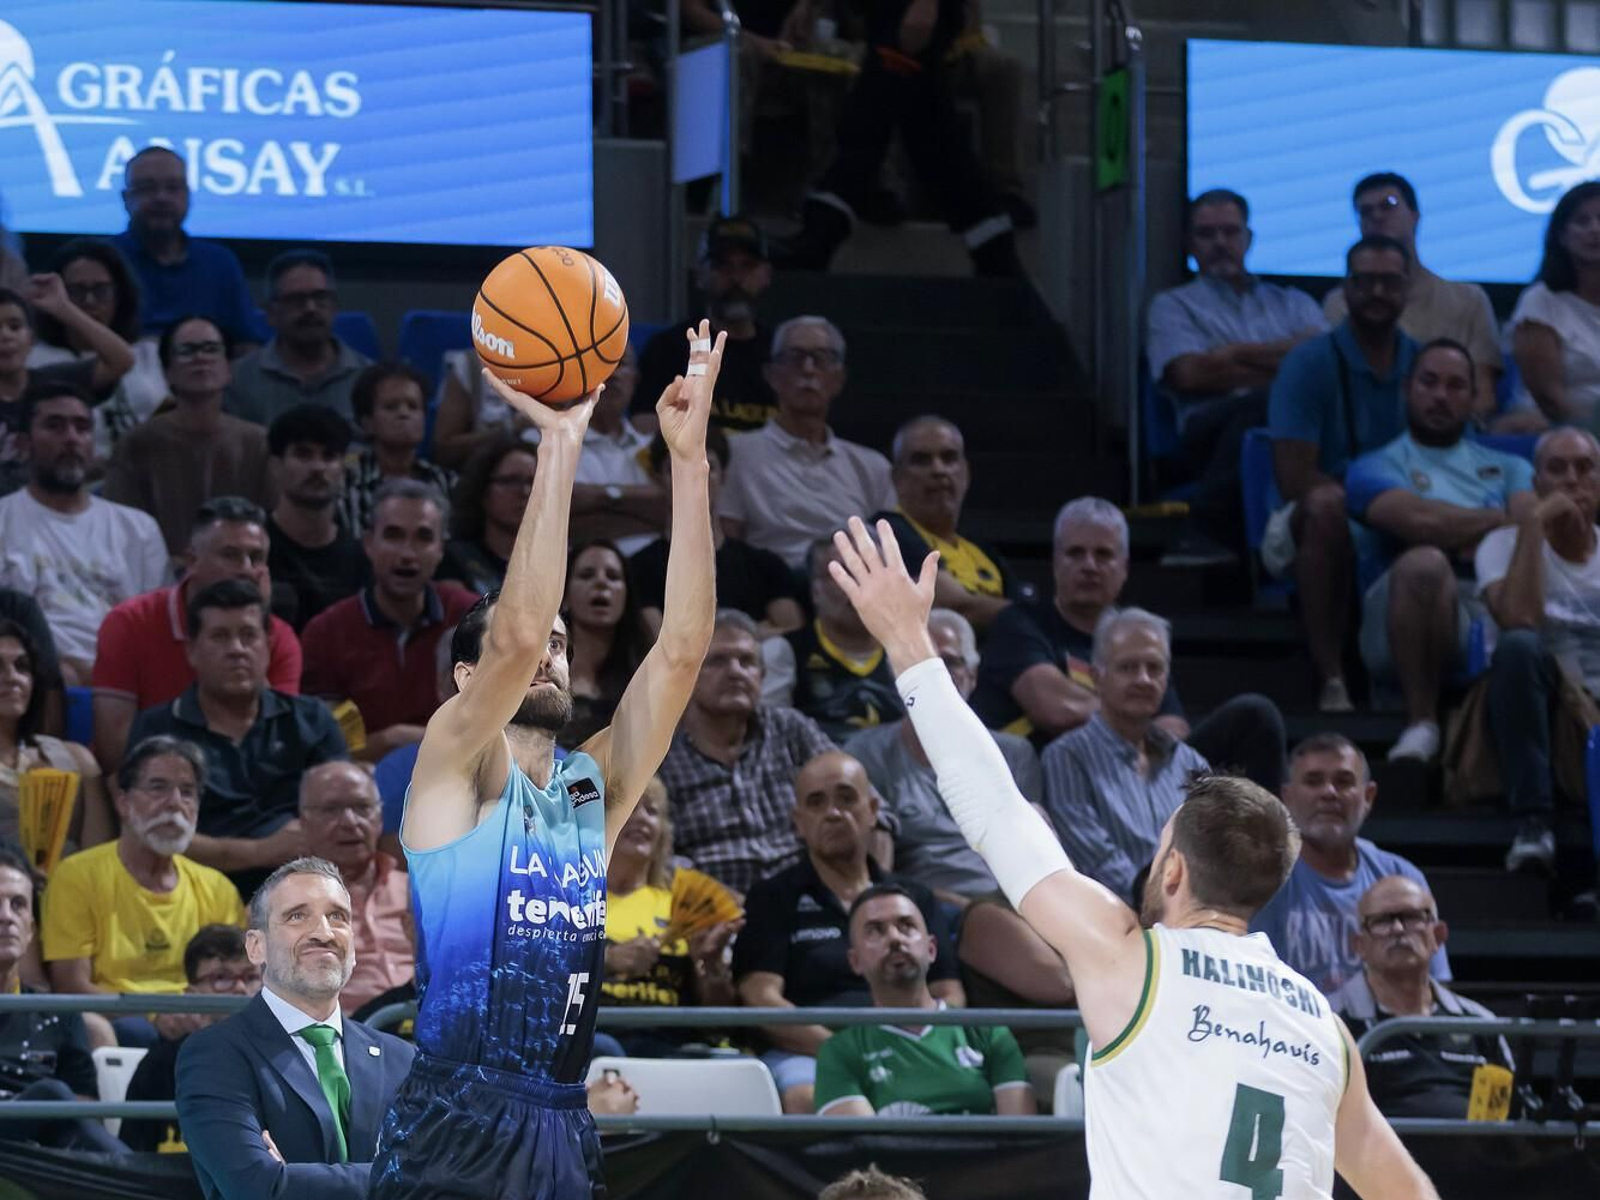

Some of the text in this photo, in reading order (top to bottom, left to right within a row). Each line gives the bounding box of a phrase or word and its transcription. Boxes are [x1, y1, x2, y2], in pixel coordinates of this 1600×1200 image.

[58, 50, 361, 118] GRÁFICAS
[510, 845, 548, 878] LA
[507, 924, 577, 942] despierta
